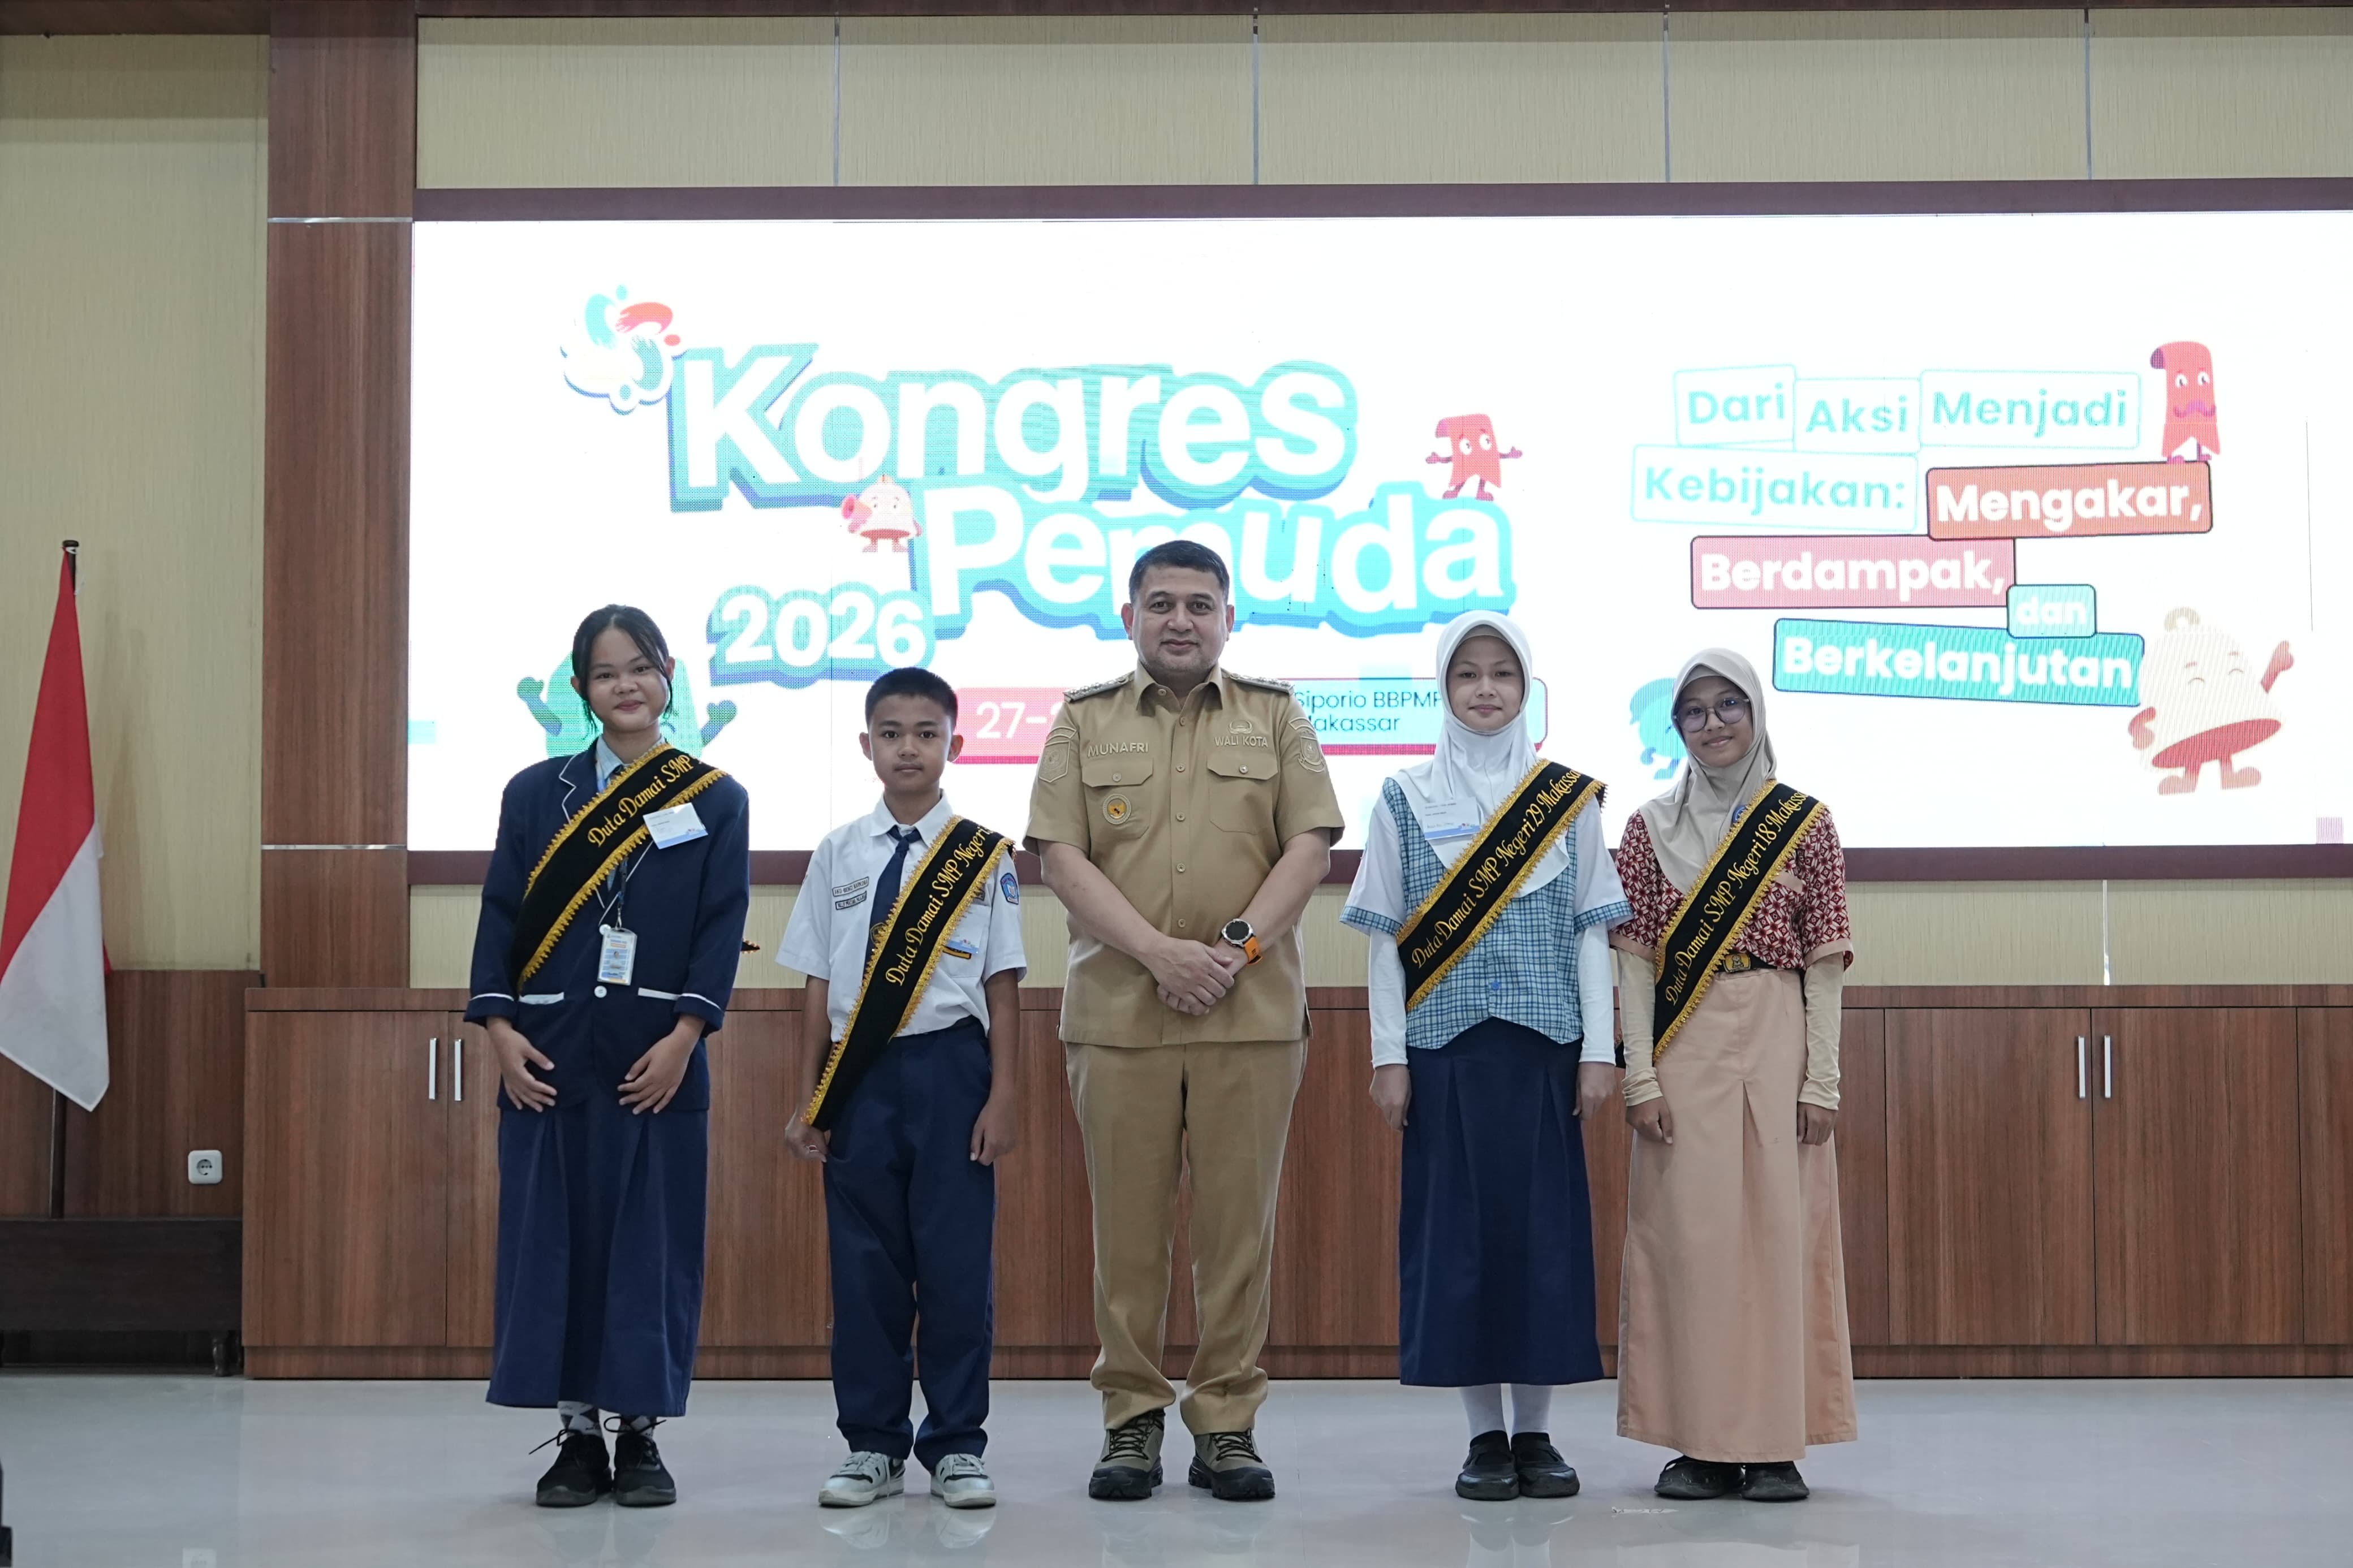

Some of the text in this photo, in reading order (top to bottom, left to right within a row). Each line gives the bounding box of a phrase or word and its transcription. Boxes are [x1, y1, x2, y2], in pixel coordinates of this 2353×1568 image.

[683, 357, 1347, 503] Kongres
[1689, 382, 2127, 438] Dari Aksi Menjadi
[1647, 466, 2202, 532] Kebijakan: Mengakar,
[1701, 551, 2005, 602] Berdampak,
[722, 591, 926, 668] 2026
[2017, 596, 2087, 625] dan
[1783, 638, 2133, 695] Berkelanjutan
[976, 701, 1063, 739] 27-
[1294, 691, 1367, 714] Siporio
[1308, 715, 1400, 732] akassar
[1087, 742, 1149, 758] MUNAFRI
[1214, 736, 1268, 748] WALI KOTA
[588, 754, 694, 846] Duta Damai SMP
[1755, 823, 1777, 845] 18
[1412, 936, 1442, 969] Duta
[1436, 893, 1476, 941] Damai
[1468, 857, 1501, 898] SMP
[1496, 818, 1536, 867] Negeri
[1525, 803, 1545, 827] 29
[1727, 839, 1766, 889] Negeri
[886, 826, 991, 986] Duta Damai SMP Negeri
[1704, 880, 1736, 922] SMP
[1675, 919, 1714, 969] Damai
[1666, 968, 1687, 1005] Duta
